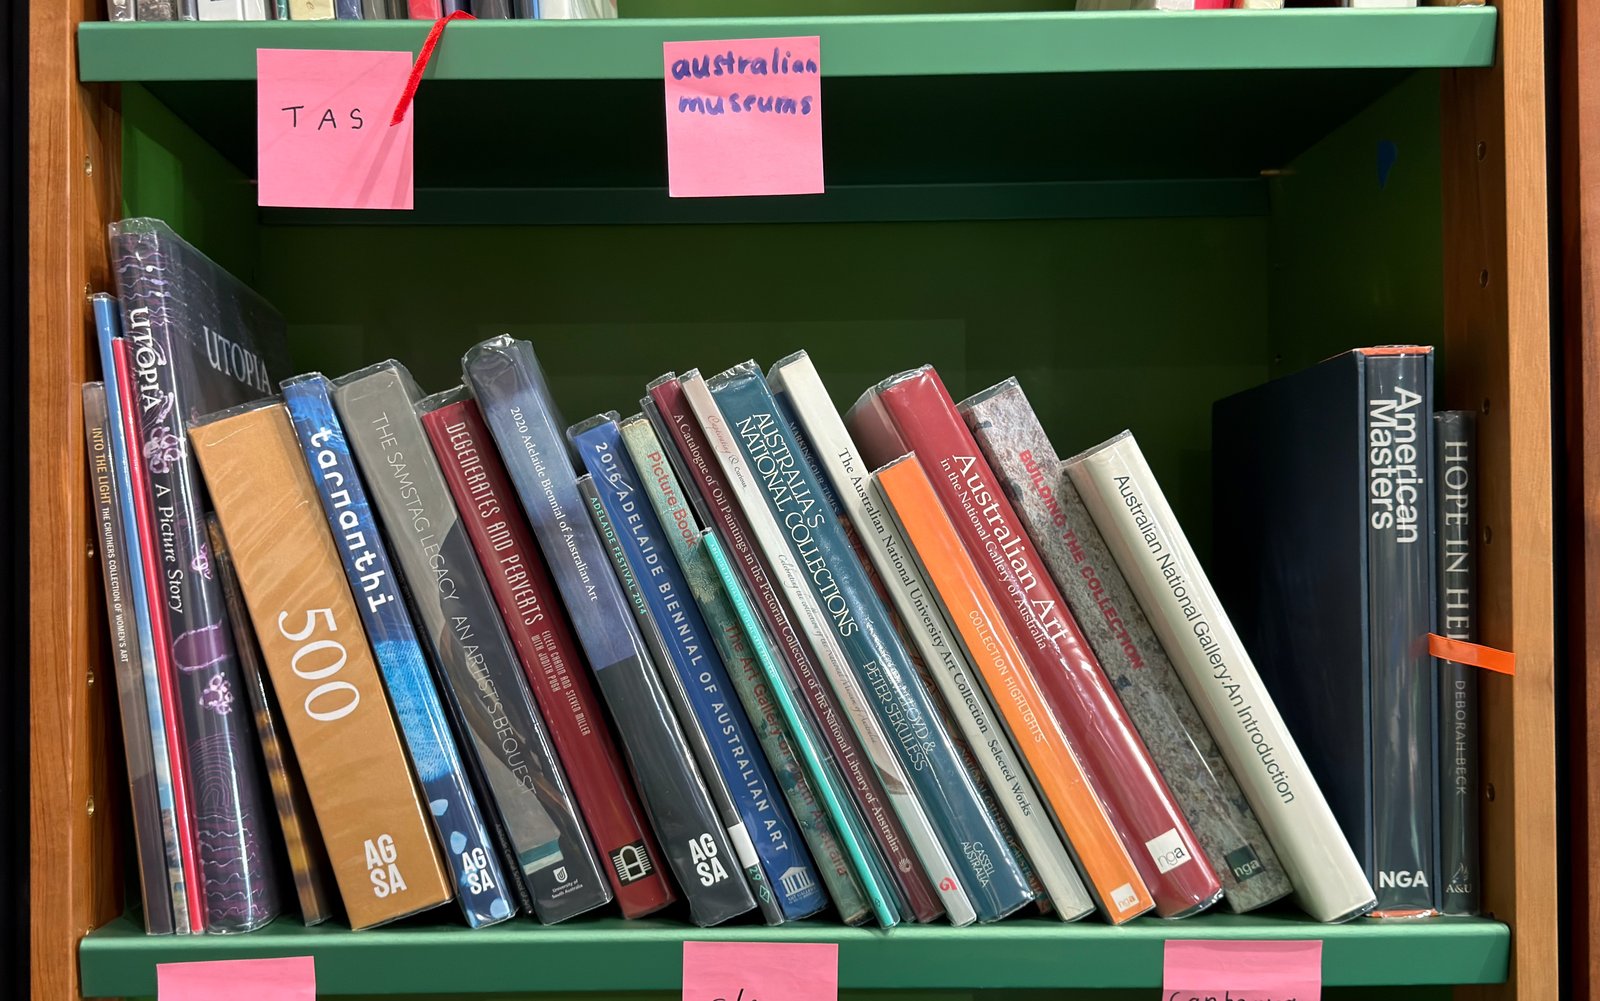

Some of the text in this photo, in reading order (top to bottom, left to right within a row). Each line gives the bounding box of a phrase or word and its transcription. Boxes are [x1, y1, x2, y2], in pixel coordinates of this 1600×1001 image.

[671, 47, 818, 80] australian
[281, 104, 365, 131] TAS
[678, 92, 813, 115] museums
[128, 306, 161, 413] UTOPIA
[203, 326, 273, 394] UTOPIA
[92, 427, 110, 504] INTO THE LIGHT
[646, 450, 681, 506] Picture
[732, 465, 749, 489] Curious
[752, 406, 828, 530] AUSTRALIA'S
[1369, 399, 1398, 530] Masters
[1394, 386, 1424, 543] American
[305, 424, 395, 612] tarnanthi
[444, 420, 545, 627] DEGENERATES AND PERVERTS
[508, 405, 600, 602] 2020 Adelaide Biennial of Australian Art
[671, 506, 700, 548] Book
[733, 415, 859, 638] NATIONAL COLLECTIONS
[155, 482, 187, 614] A Picture Story
[588, 495, 648, 615] ADELAIDE FESTIVAL 2014
[939, 457, 1049, 649] in the National Gallery of Australia
[950, 445, 1073, 644] Australian Art
[1017, 447, 1145, 672] BUILDING THE COLLECTION
[1445, 441, 1470, 664] HOPE IN HE
[101, 507, 128, 662] THE CRUTHERS COLLECTION OF WOMEN'S ART
[773, 551, 803, 591] Celebrating
[795, 586, 810, 601] the
[370, 412, 397, 450] THE
[386, 450, 430, 532] SAMSTAG
[419, 533, 459, 604] LEGACY
[450, 611, 474, 641] AN
[462, 641, 503, 714] ARTIST'S
[491, 715, 537, 798] BEQUEST
[800, 597, 824, 629] collection
[541, 629, 557, 651] EILEEN
[595, 441, 788, 853] 2016 ADELAIDE BIENNIAL OF AUSTRALIAN ART
[672, 411, 902, 853] A Catalogue of Oil Paintings in the Pictorial Collection of the National Library of Australia
[724, 622, 748, 653] The
[819, 635, 832, 648] the
[835, 447, 1035, 817] The Australian National University Art Collection Selected Works
[1112, 471, 1166, 554] Australian
[1155, 552, 1202, 622] National
[1236, 704, 1299, 804] Introduction
[278, 608, 360, 721] 500
[531, 633, 561, 692] WITH JUDITH PUGH
[558, 674, 572, 689] AND
[738, 653, 761, 680] Art
[825, 647, 846, 677] National
[968, 608, 1044, 743] COLLECTION HIGHLIGHTS
[564, 688, 581, 712] STEVEN
[574, 712, 591, 736] MILLER
[749, 681, 786, 736] Gallery
[862, 659, 893, 705] PETER
[883, 701, 928, 772] SEKULESS
[920, 737, 938, 755] &
[1455, 680, 1467, 795] DEBORAH BECK
[364, 833, 397, 870] AG
[461, 847, 487, 874] AG
[688, 833, 718, 865] AG
[696, 857, 729, 887] SA
[960, 839, 990, 888] AUSTRALIA
[971, 840, 995, 877] CASSELL
[1157, 846, 1185, 868] nga
[1233, 859, 1260, 878] nga
[370, 863, 407, 898] SA
[467, 868, 495, 895] SA
[1379, 870, 1429, 888] NGA
[1446, 883, 1472, 894] A&U
